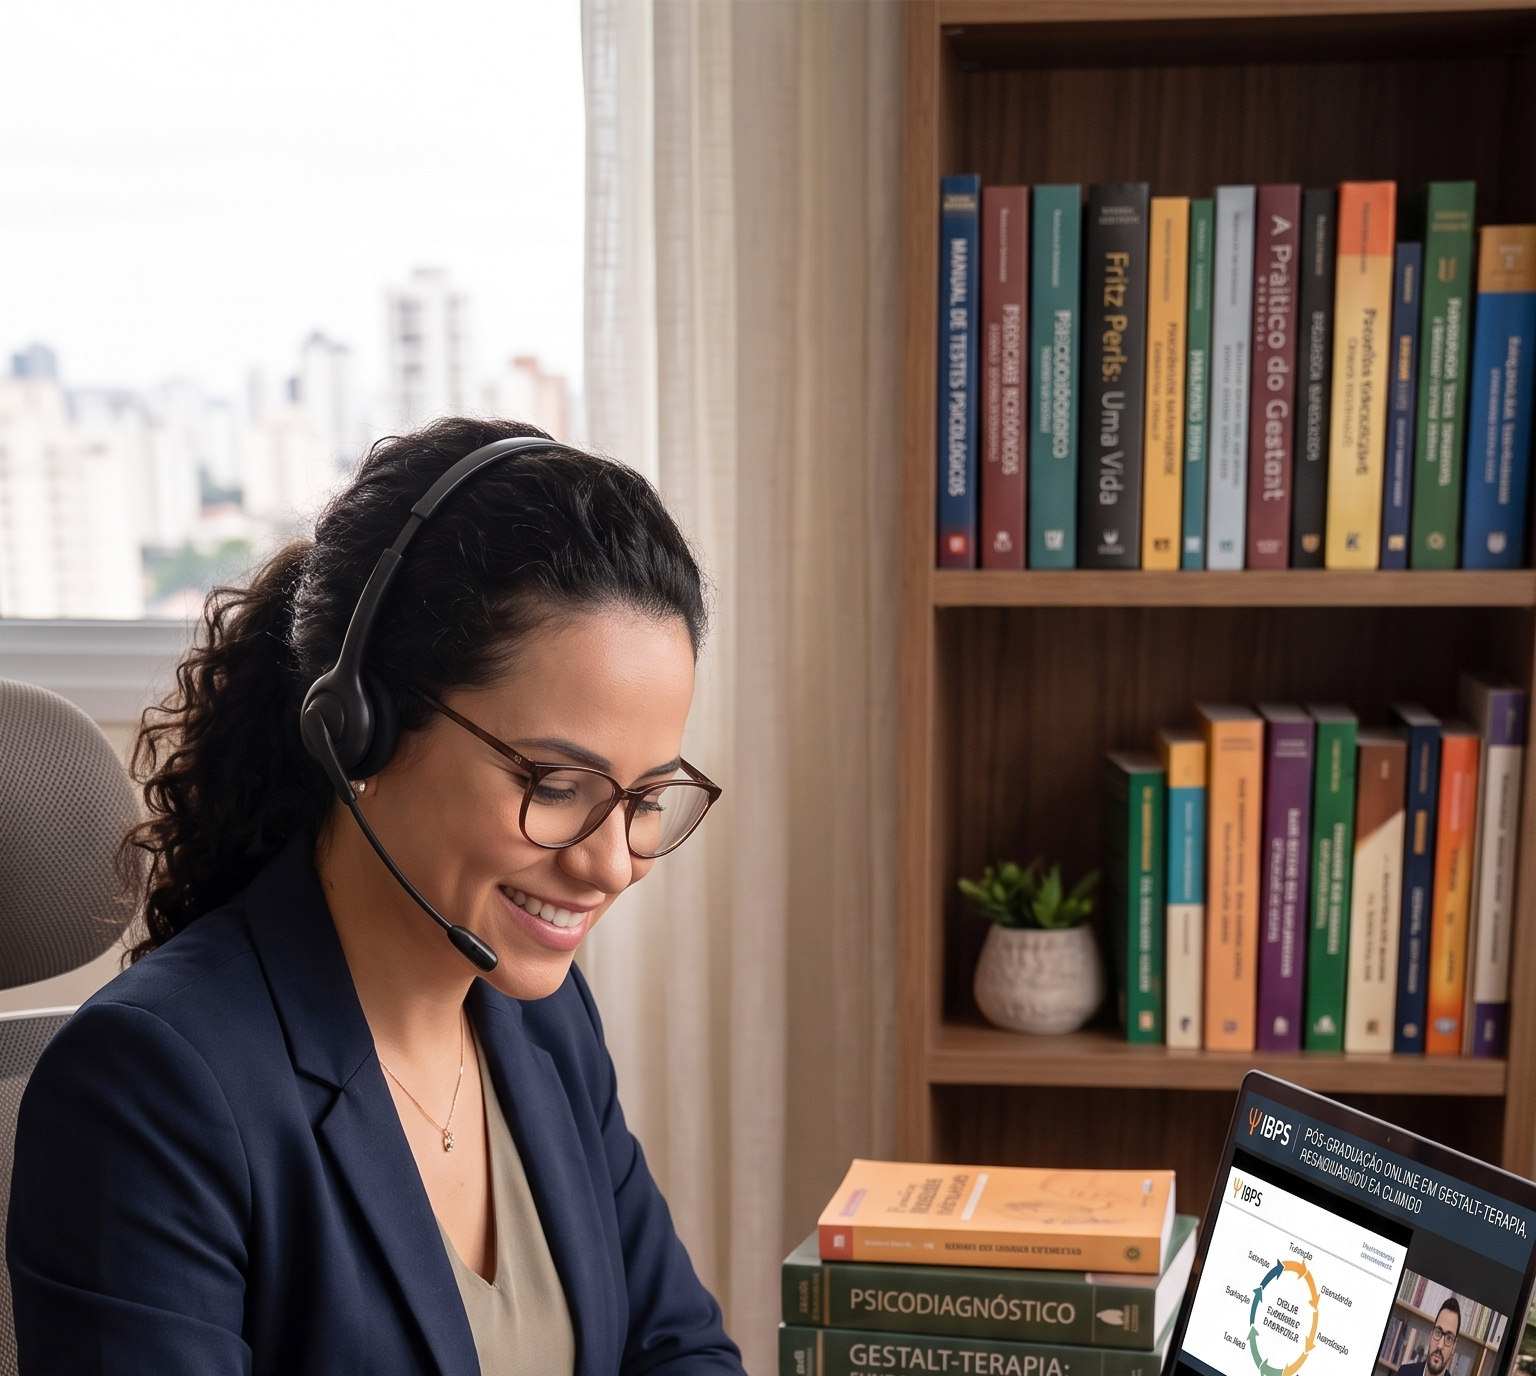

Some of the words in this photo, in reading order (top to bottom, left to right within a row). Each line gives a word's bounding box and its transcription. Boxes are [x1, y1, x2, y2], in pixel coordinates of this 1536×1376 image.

[1271, 215, 1292, 236] A
[1103, 252, 1130, 307] Fritz
[949, 308, 968, 331] DE
[1102, 314, 1128, 382] Perls:
[1267, 356, 1289, 391] do
[1100, 391, 1126, 447] Uma
[1099, 450, 1125, 505] Vida
[1260, 1114, 1292, 1146] IBPS
[1241, 1185, 1263, 1207] IBPS
[1384, 1162, 1421, 1191] ONLINE
[1420, 1178, 1438, 1198] EM
[850, 1288, 1076, 1324] PSICODIAGNÓSTICO
